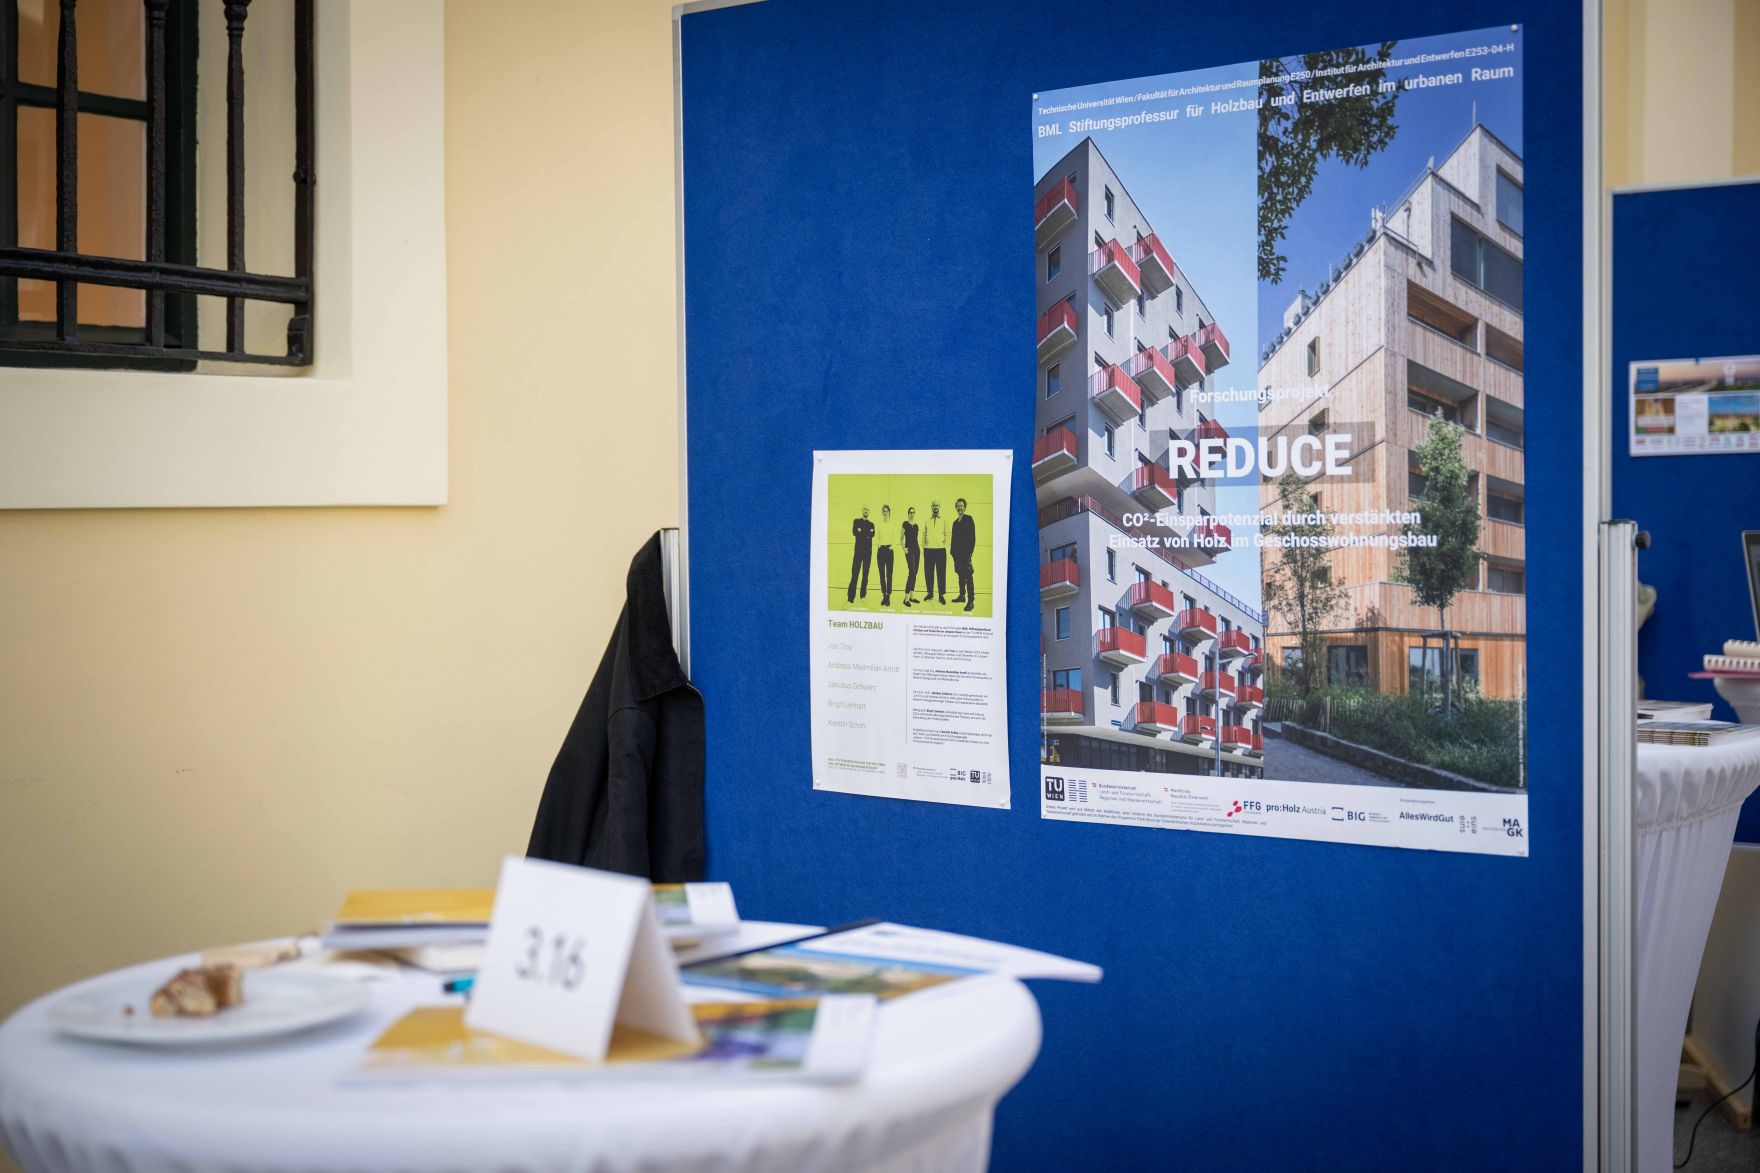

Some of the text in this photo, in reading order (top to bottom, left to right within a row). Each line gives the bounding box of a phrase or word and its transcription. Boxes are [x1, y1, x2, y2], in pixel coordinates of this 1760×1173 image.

[1038, 103, 1077, 116] Technische
[1077, 96, 1116, 110] Universität
[1115, 92, 1134, 105] Wien
[1137, 89, 1168, 102] Fakultät
[1167, 88, 1179, 98] für
[1179, 83, 1222, 96] Architektur
[1221, 80, 1237, 91] und
[1236, 74, 1290, 89] Raumplanung
[1290, 70, 1311, 80] E250
[1315, 66, 1345, 78] Institut
[1344, 63, 1358, 74] für
[1358, 58, 1404, 72] Architektur
[1403, 55, 1421, 66] und
[1421, 50, 1465, 63] Entwerfen
[1465, 43, 1515, 57] E253-04-H
[1038, 66, 1514, 138] BML Stiftungsprofessur für Holzbau und Entwerfen im urbanen Raum
[1190, 384, 1331, 405] Forschungsprojekt
[1168, 433, 1353, 480] REDUCE
[1281, 510, 1326, 526] durch
[1330, 508, 1421, 526] verstärkten
[1108, 531, 1438, 551] Einsatz von Holz im Geschosswohnungsbau
[827, 619, 884, 630] Team HOLZBAU
[1046, 778, 1063, 792] TU
[1047, 792, 1064, 800] WIEN
[1243, 800, 1262, 811] FFG
[1302, 805, 1327, 815] Austria
[1347, 811, 1366, 822] BIG
[1399, 811, 1454, 823] AllesWirdGut
[1502, 818, 1520, 828] MA
[1506, 827, 1524, 838] GK
[514, 924, 587, 991] 3.16
